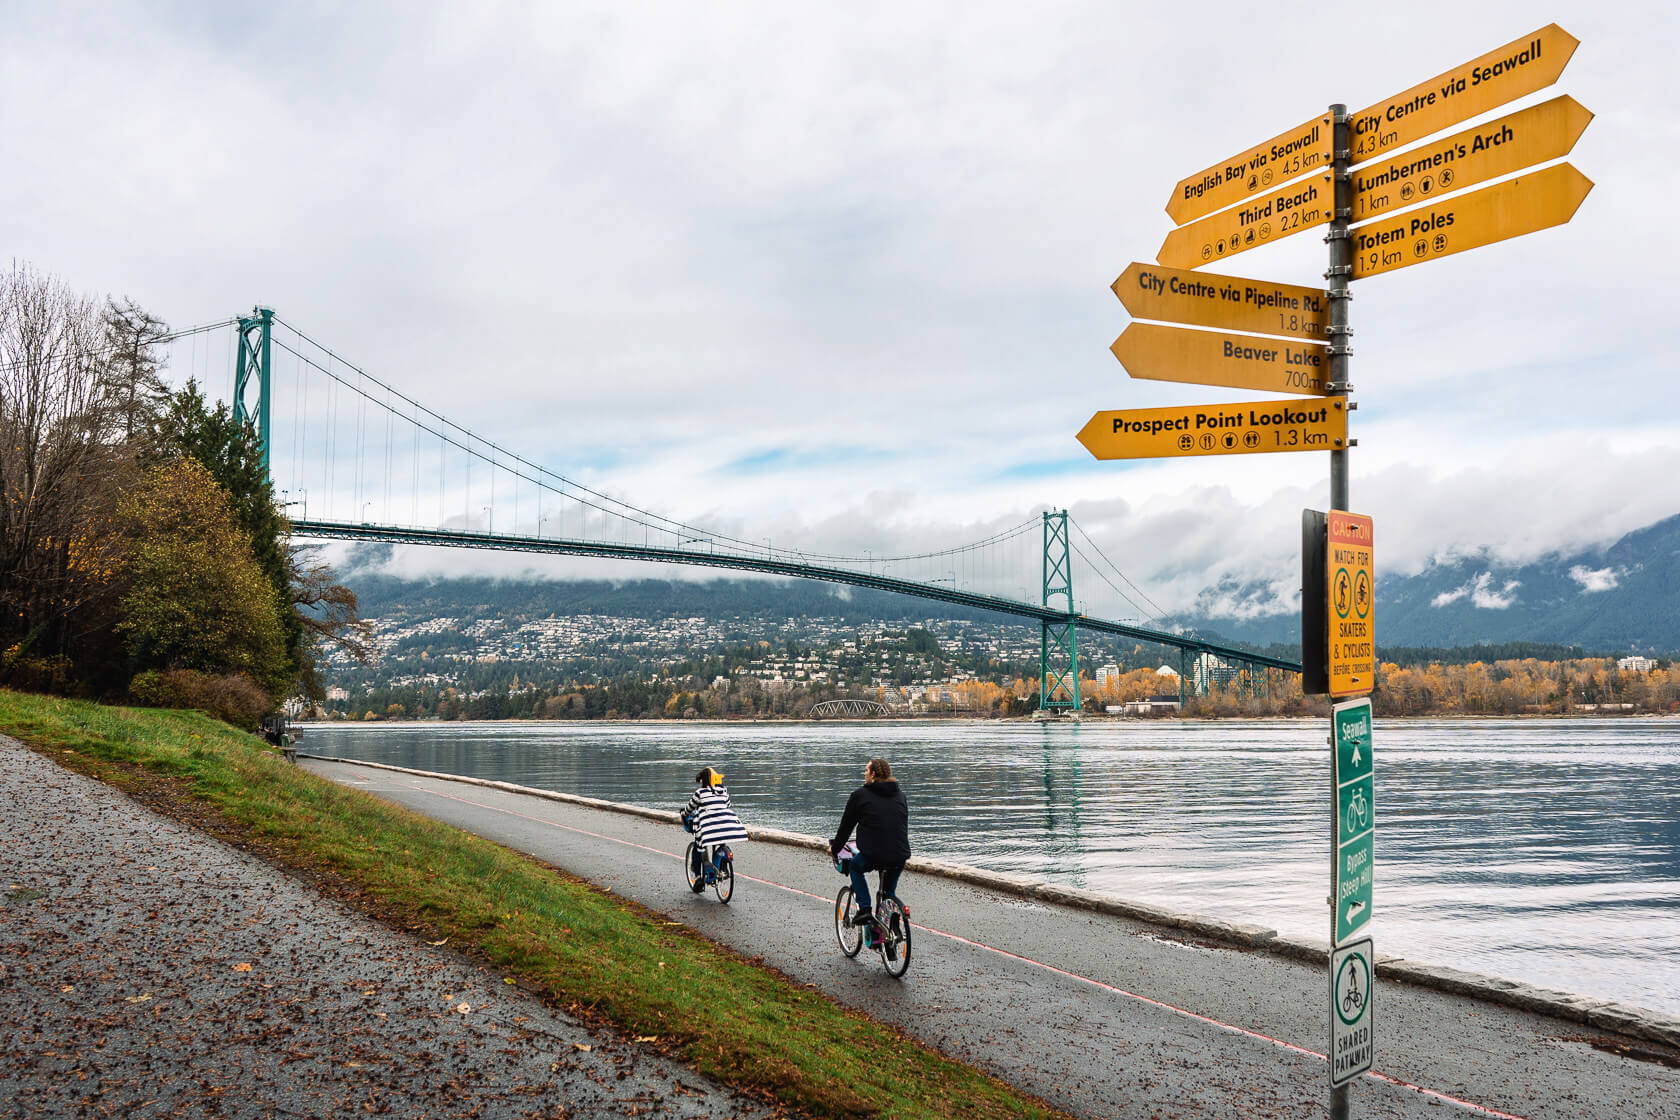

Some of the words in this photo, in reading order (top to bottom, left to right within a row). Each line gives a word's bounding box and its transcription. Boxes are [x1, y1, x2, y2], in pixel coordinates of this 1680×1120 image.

[1355, 113, 1382, 136] City
[1386, 89, 1436, 122] Centre
[1441, 78, 1466, 99] via
[1471, 38, 1542, 86] Seawall
[1357, 138, 1376, 156] 4.3
[1379, 130, 1398, 148] km
[1184, 173, 1222, 200] English
[1226, 163, 1246, 182] Bay
[1250, 153, 1267, 170] via
[1271, 126, 1319, 161] Seawall
[1283, 159, 1300, 175] 4.5
[1302, 152, 1319, 167] km
[1358, 143, 1466, 193] Lumbermen's
[1471, 124, 1513, 154] Arch
[1239, 201, 1272, 227] Third
[1277, 185, 1317, 212] Beach
[1360, 198, 1365, 214] 1
[1370, 192, 1389, 210] km
[1281, 212, 1298, 231] 2.2
[1302, 207, 1319, 225] km
[1358, 226, 1405, 251] Totem
[1411, 212, 1454, 236] Poles
[1359, 254, 1379, 273] 1.9
[1382, 250, 1402, 267] km
[1139, 272, 1165, 296] City
[1170, 276, 1215, 298] Centre
[1219, 284, 1240, 302] via
[1245, 287, 1299, 309] Pipeline
[1303, 295, 1323, 313] Rd.
[1279, 314, 1298, 331] 1.8
[1302, 317, 1320, 335] km
[1223, 341, 1278, 362] Beaver
[1285, 348, 1320, 367] Lake
[1285, 371, 1320, 389] 700m
[1112, 415, 1189, 435] Prospect
[1196, 412, 1243, 429] Point
[1250, 407, 1327, 426] Lookout
[1274, 430, 1298, 446] 1.3
[1303, 428, 1327, 444] km
[1334, 550, 1355, 566] WATCH
[1358, 552, 1369, 566] FOR
[1339, 622, 1367, 638] SKATERS
[1334, 643, 1340, 660] &
[1344, 643, 1371, 659] CYCLISTS
[1333, 663, 1350, 676] BEFORE
[1352, 662, 1371, 674] CROSSING
[1342, 716, 1368, 741] Seawall
[1347, 848, 1367, 875] Bypass
[1338, 1027, 1368, 1054] SHARED
[1336, 1045, 1370, 1075] PATHWAY
